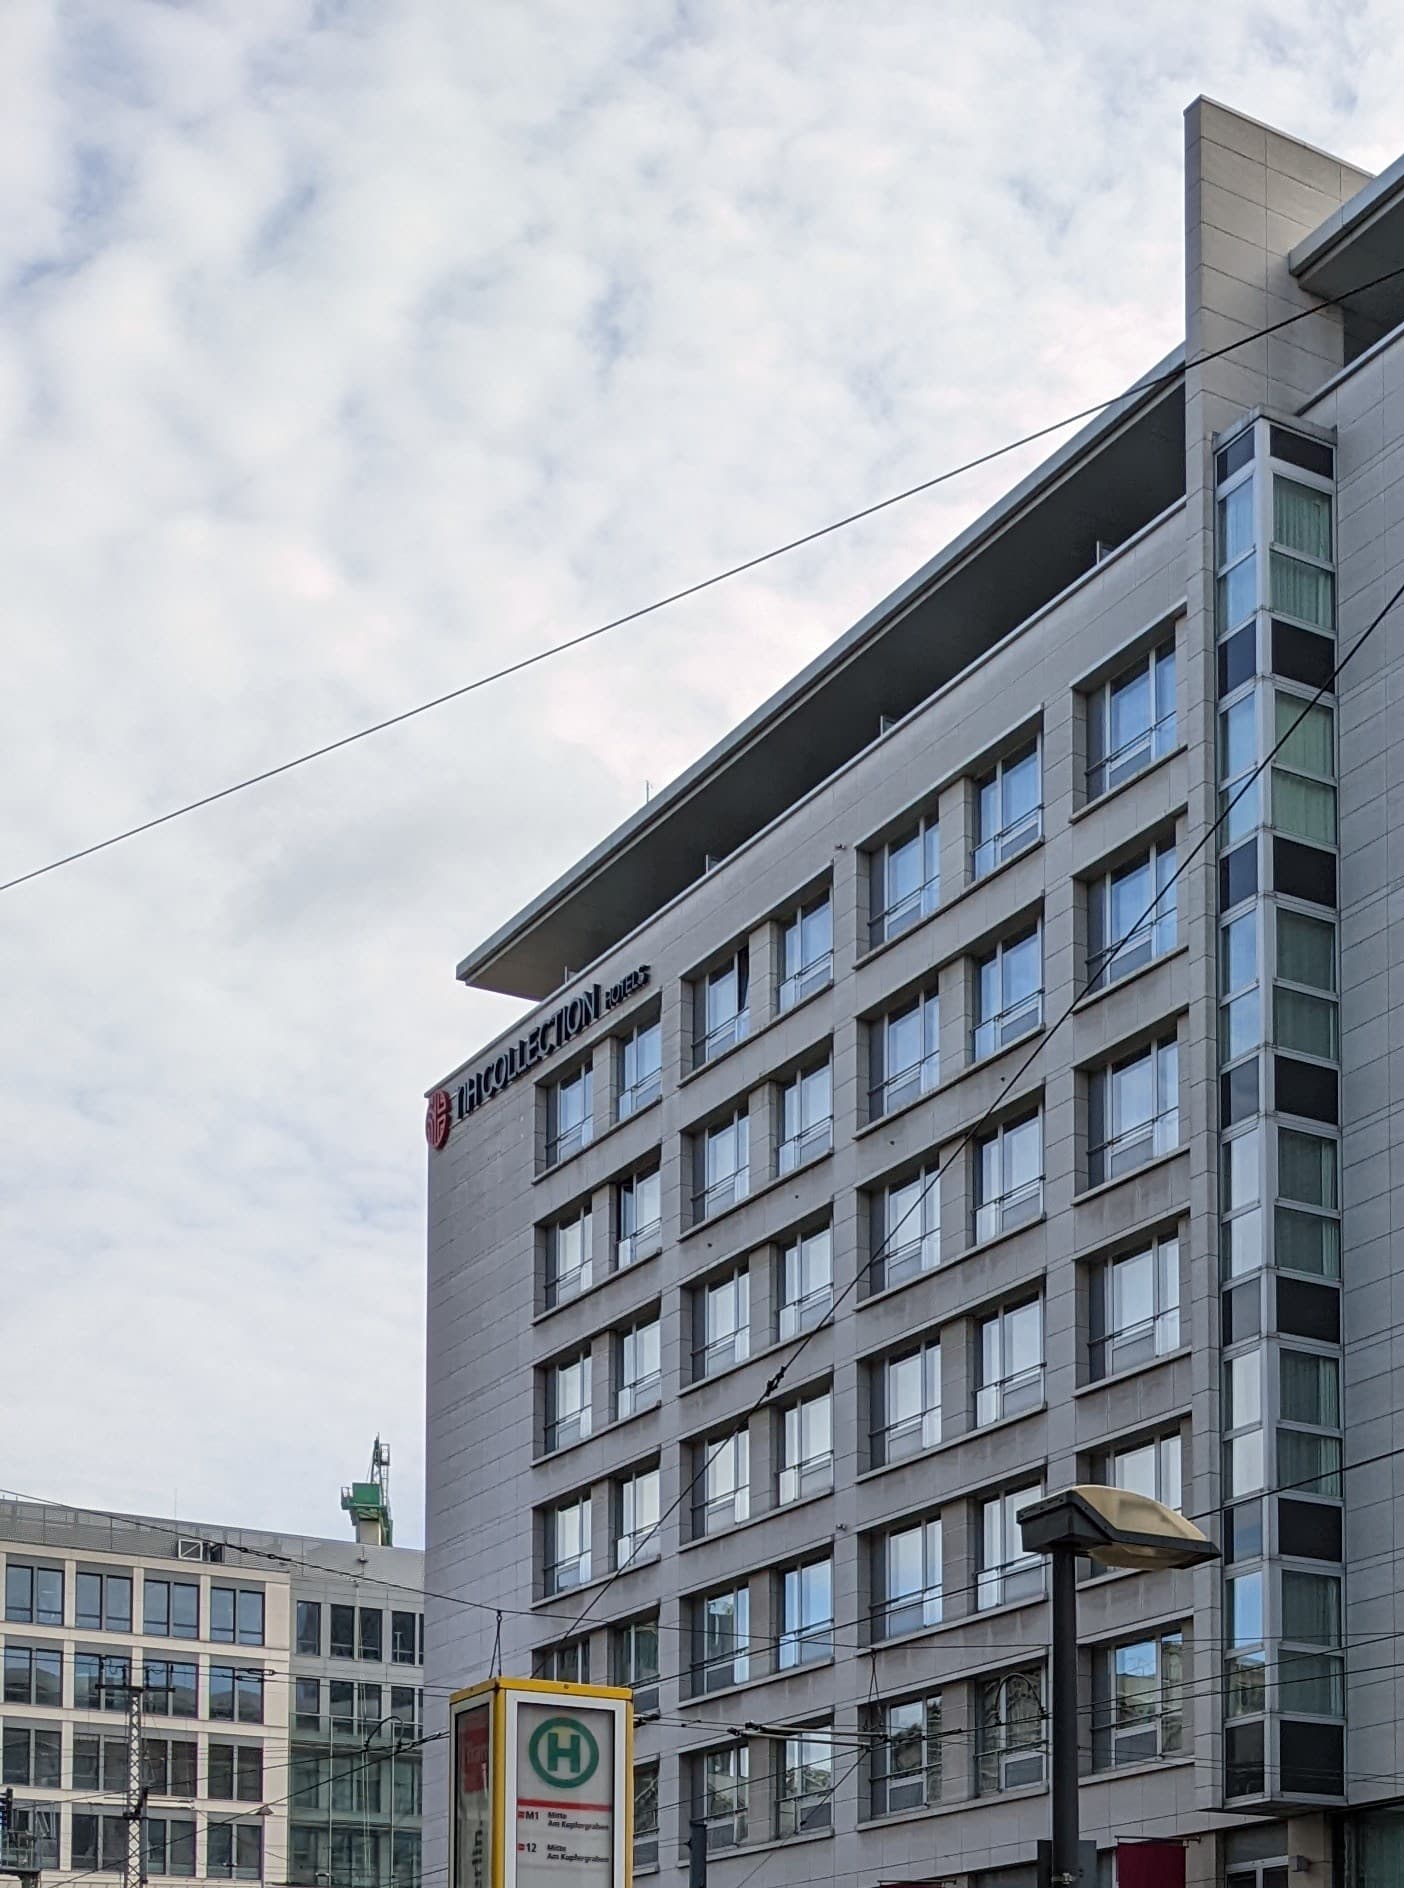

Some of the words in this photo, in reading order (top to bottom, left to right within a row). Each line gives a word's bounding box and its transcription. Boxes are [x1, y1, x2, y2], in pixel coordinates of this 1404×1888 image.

[483, 984, 601, 1098] COLLECTION
[605, 965, 651, 1010] HOTELS
[525, 1811, 539, 1820] M1
[526, 1843, 537, 1852] 12
